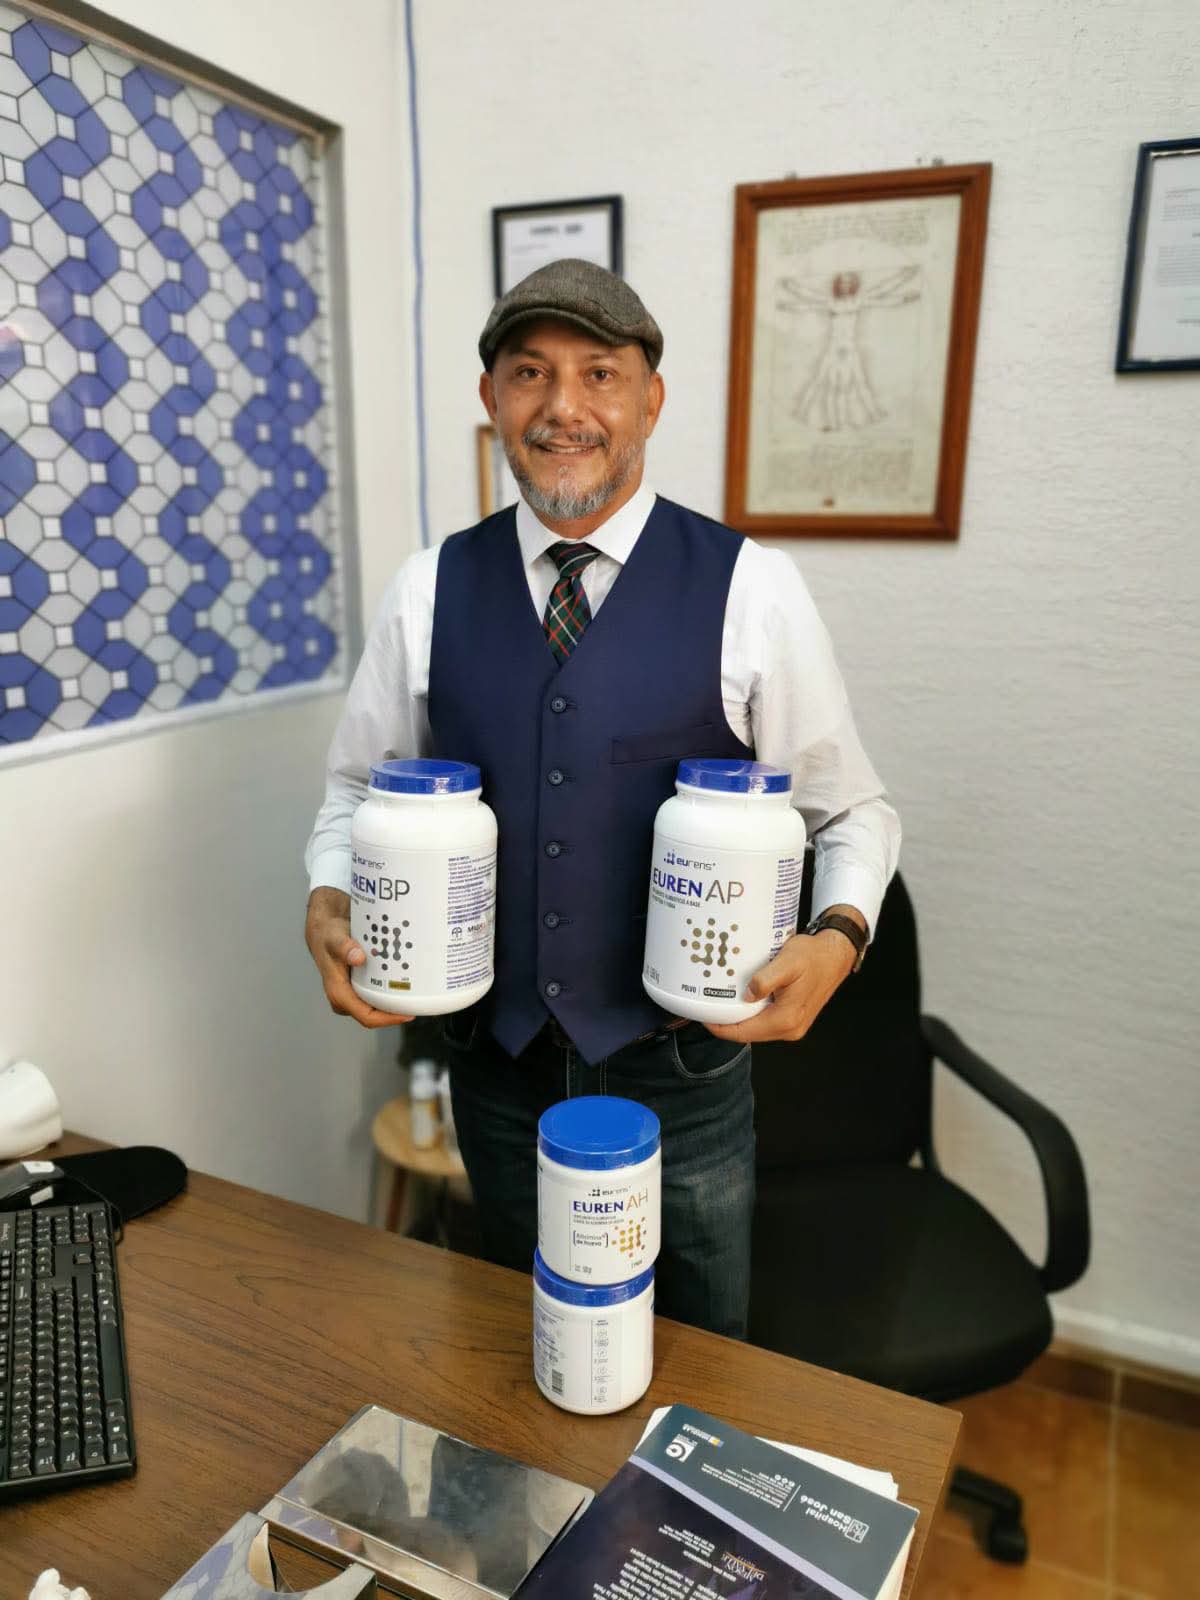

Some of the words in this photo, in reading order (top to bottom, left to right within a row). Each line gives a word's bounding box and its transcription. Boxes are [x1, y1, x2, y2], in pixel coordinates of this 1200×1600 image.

[379, 878, 410, 901] BP
[653, 868, 702, 897] EUREN
[705, 880, 744, 904] AP
[681, 984, 696, 993] POLVO
[573, 1200, 623, 1213] EUREN
[626, 1188, 648, 1212] AH
[801, 1495, 828, 1512] José
[806, 1508, 848, 1532] Hospital
[830, 1509, 851, 1524] San
